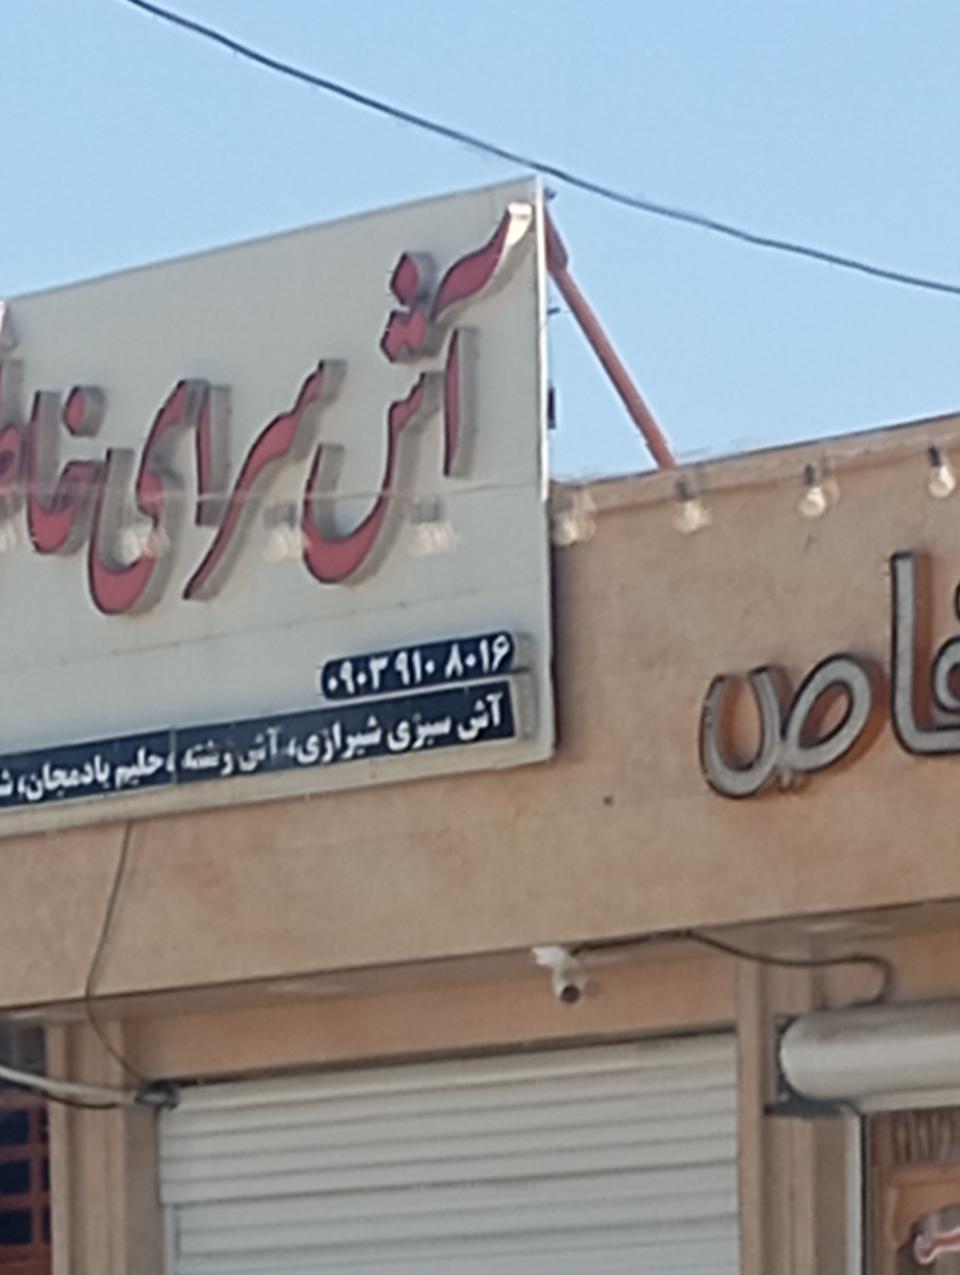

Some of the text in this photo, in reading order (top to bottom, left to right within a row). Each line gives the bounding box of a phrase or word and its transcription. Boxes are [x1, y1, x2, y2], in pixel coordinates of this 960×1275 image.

[87, 358, 346, 616] سرای
[394, 650, 435, 686] ۹۱۰
[444, 634, 511, 679] ۸۰۱۶
[386, 712, 452, 752] سبزی
[456, 690, 504, 742] آش
[239, 725, 282, 772] آش
